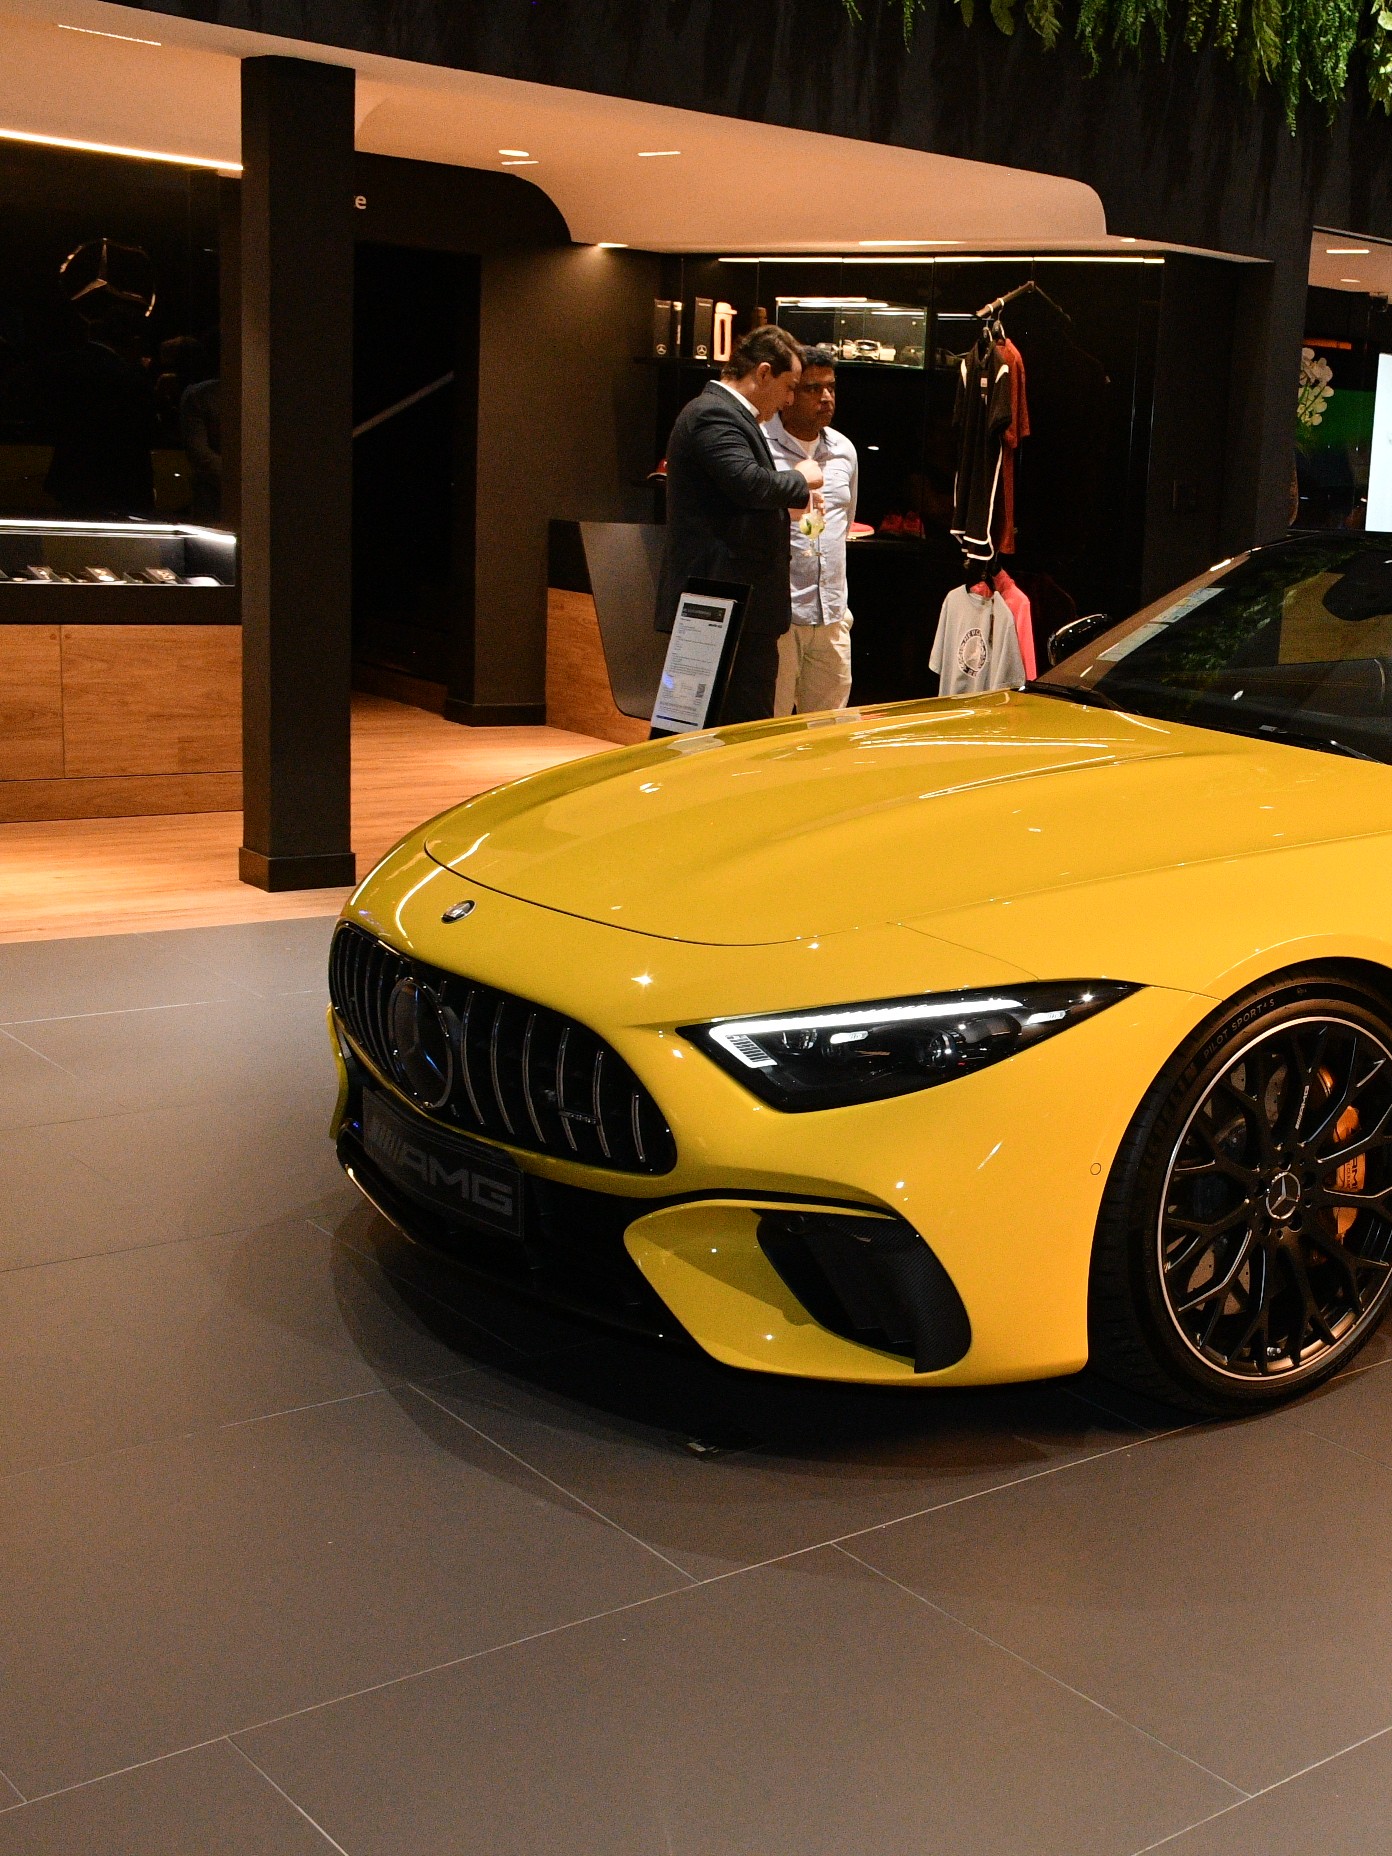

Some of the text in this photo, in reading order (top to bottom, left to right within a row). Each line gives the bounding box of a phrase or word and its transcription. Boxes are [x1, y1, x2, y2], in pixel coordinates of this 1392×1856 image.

[1203, 1030, 1229, 1060] PILOT
[1231, 1004, 1264, 1032] SPORT
[398, 1138, 513, 1218] AMG
